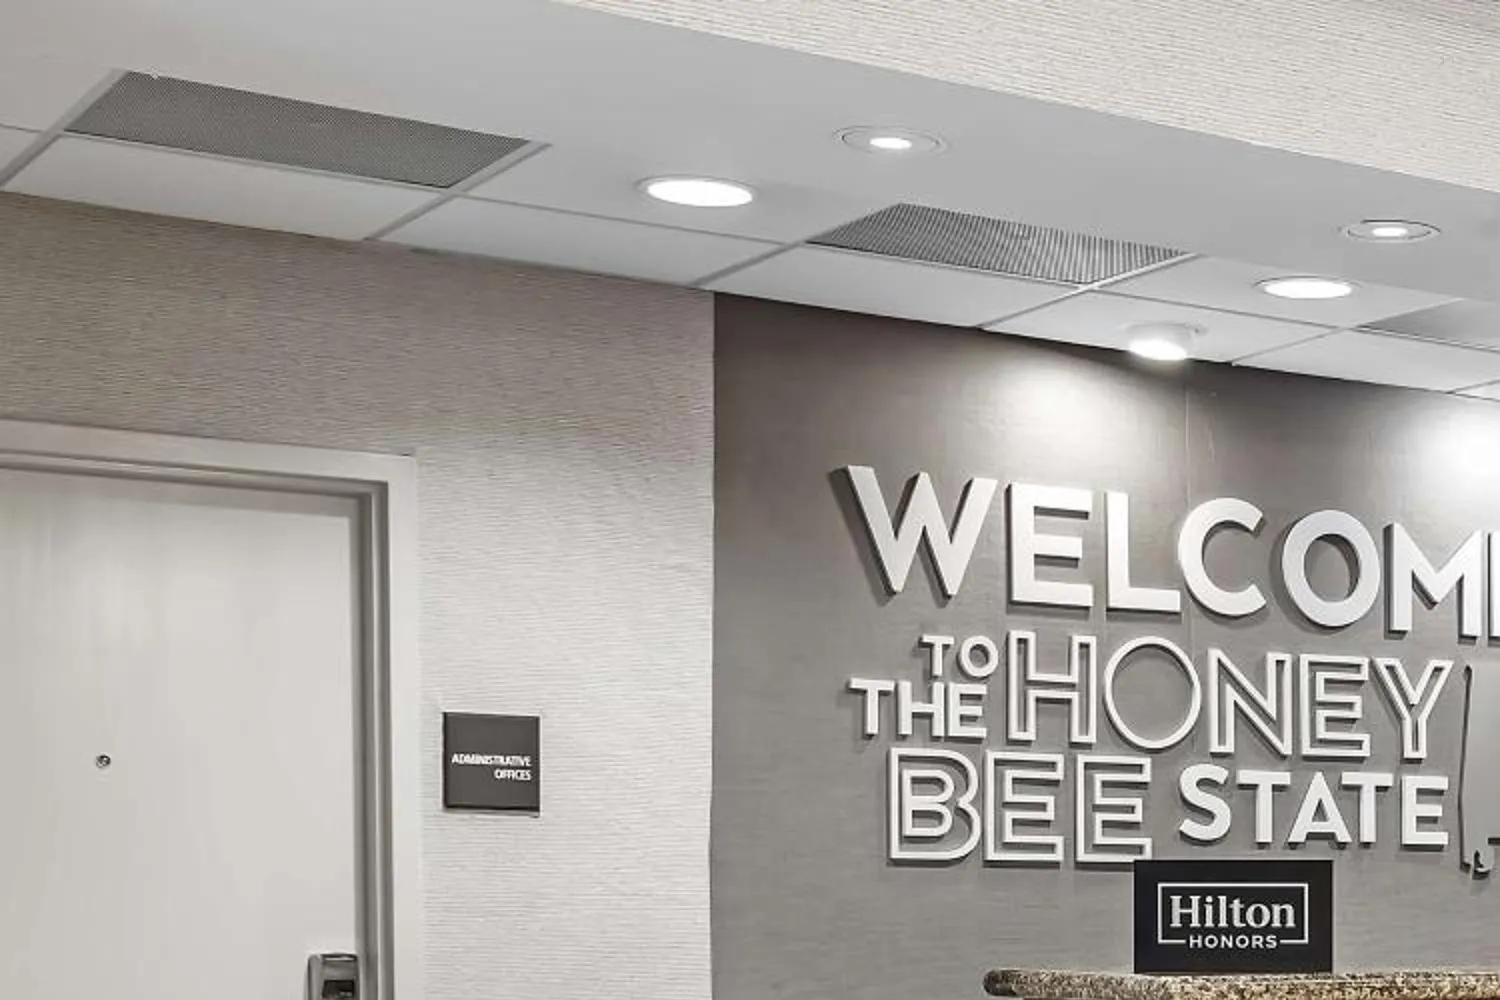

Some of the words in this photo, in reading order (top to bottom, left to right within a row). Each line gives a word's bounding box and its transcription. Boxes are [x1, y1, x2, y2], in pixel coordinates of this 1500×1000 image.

[919, 634, 999, 678] TO
[848, 677, 988, 739] THE
[1006, 629, 1454, 760] HONEY
[887, 747, 1152, 863] BEE
[1178, 763, 1449, 847] STATE
[1169, 895, 1297, 929] Hilton
[1189, 934, 1278, 949] HONORS
